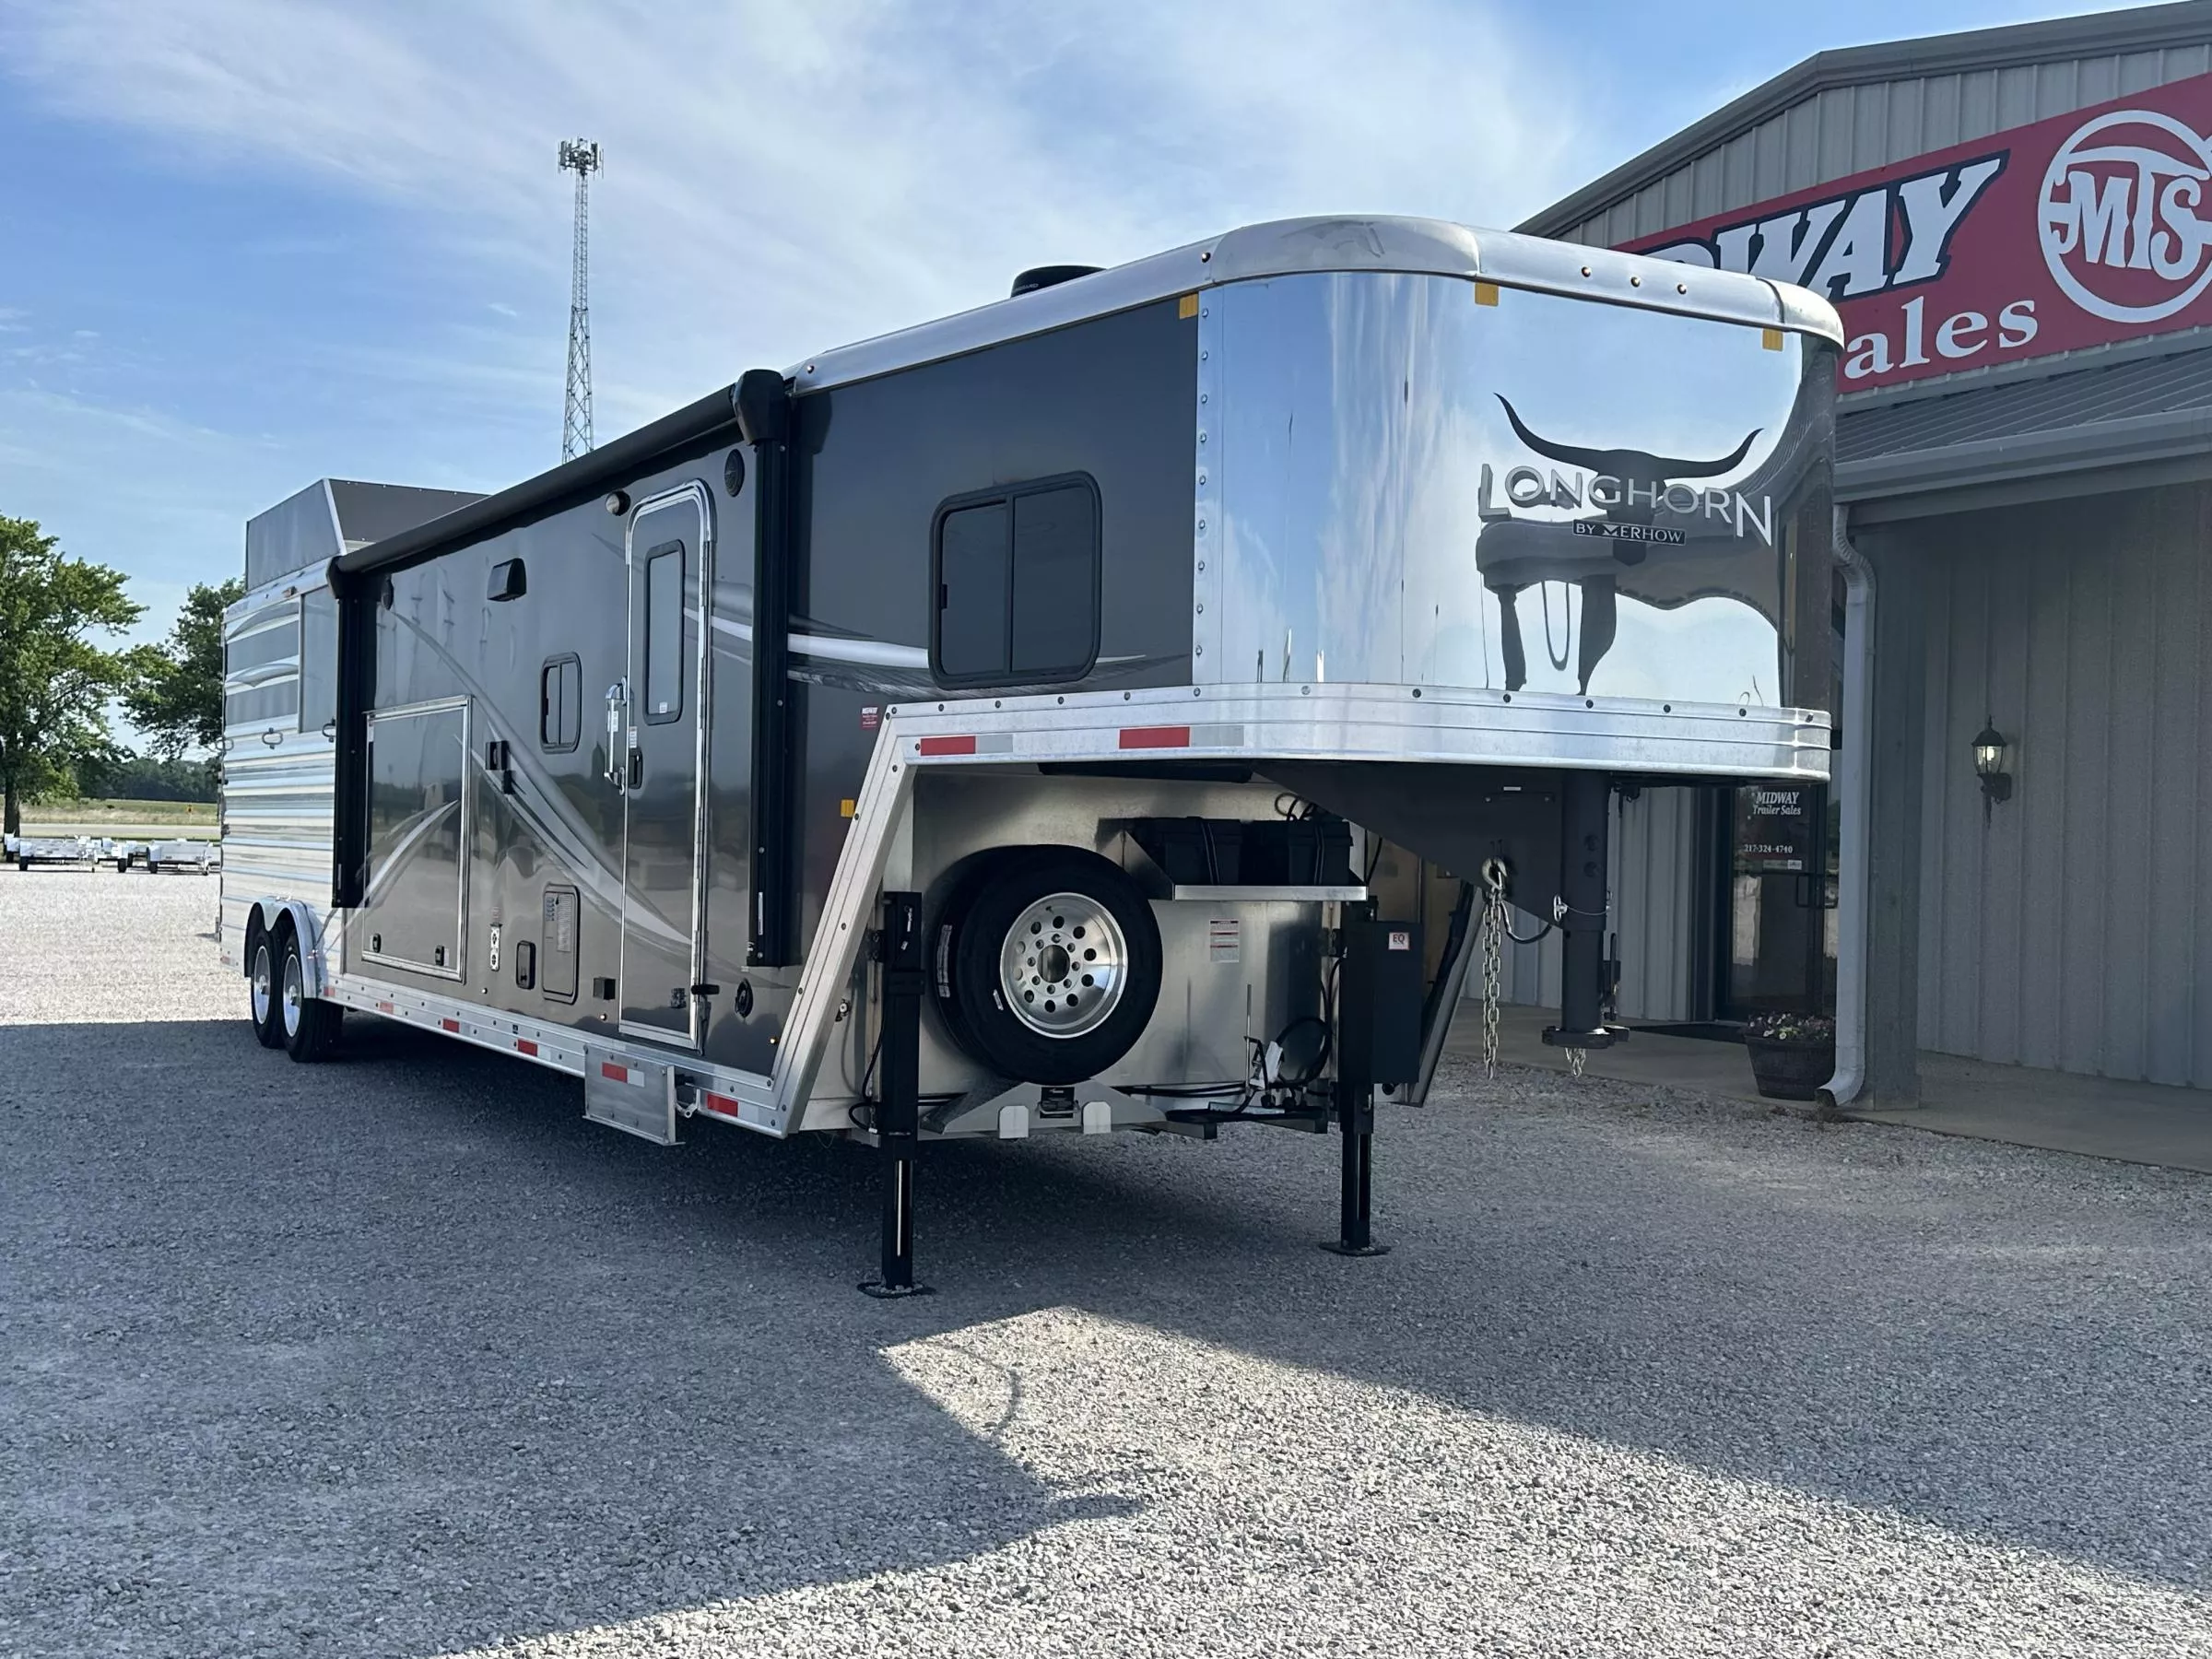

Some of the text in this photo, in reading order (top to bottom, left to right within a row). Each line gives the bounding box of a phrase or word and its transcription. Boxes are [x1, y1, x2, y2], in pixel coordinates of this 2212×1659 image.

[1643, 157, 2007, 299] WAY
[1844, 295, 2038, 380] ales
[1477, 463, 1773, 547] LONGHORN
[1576, 523, 1595, 535] BY
[1753, 805, 1802, 815] Trailer Sales
[1756, 792, 1800, 805] MIDWAY
